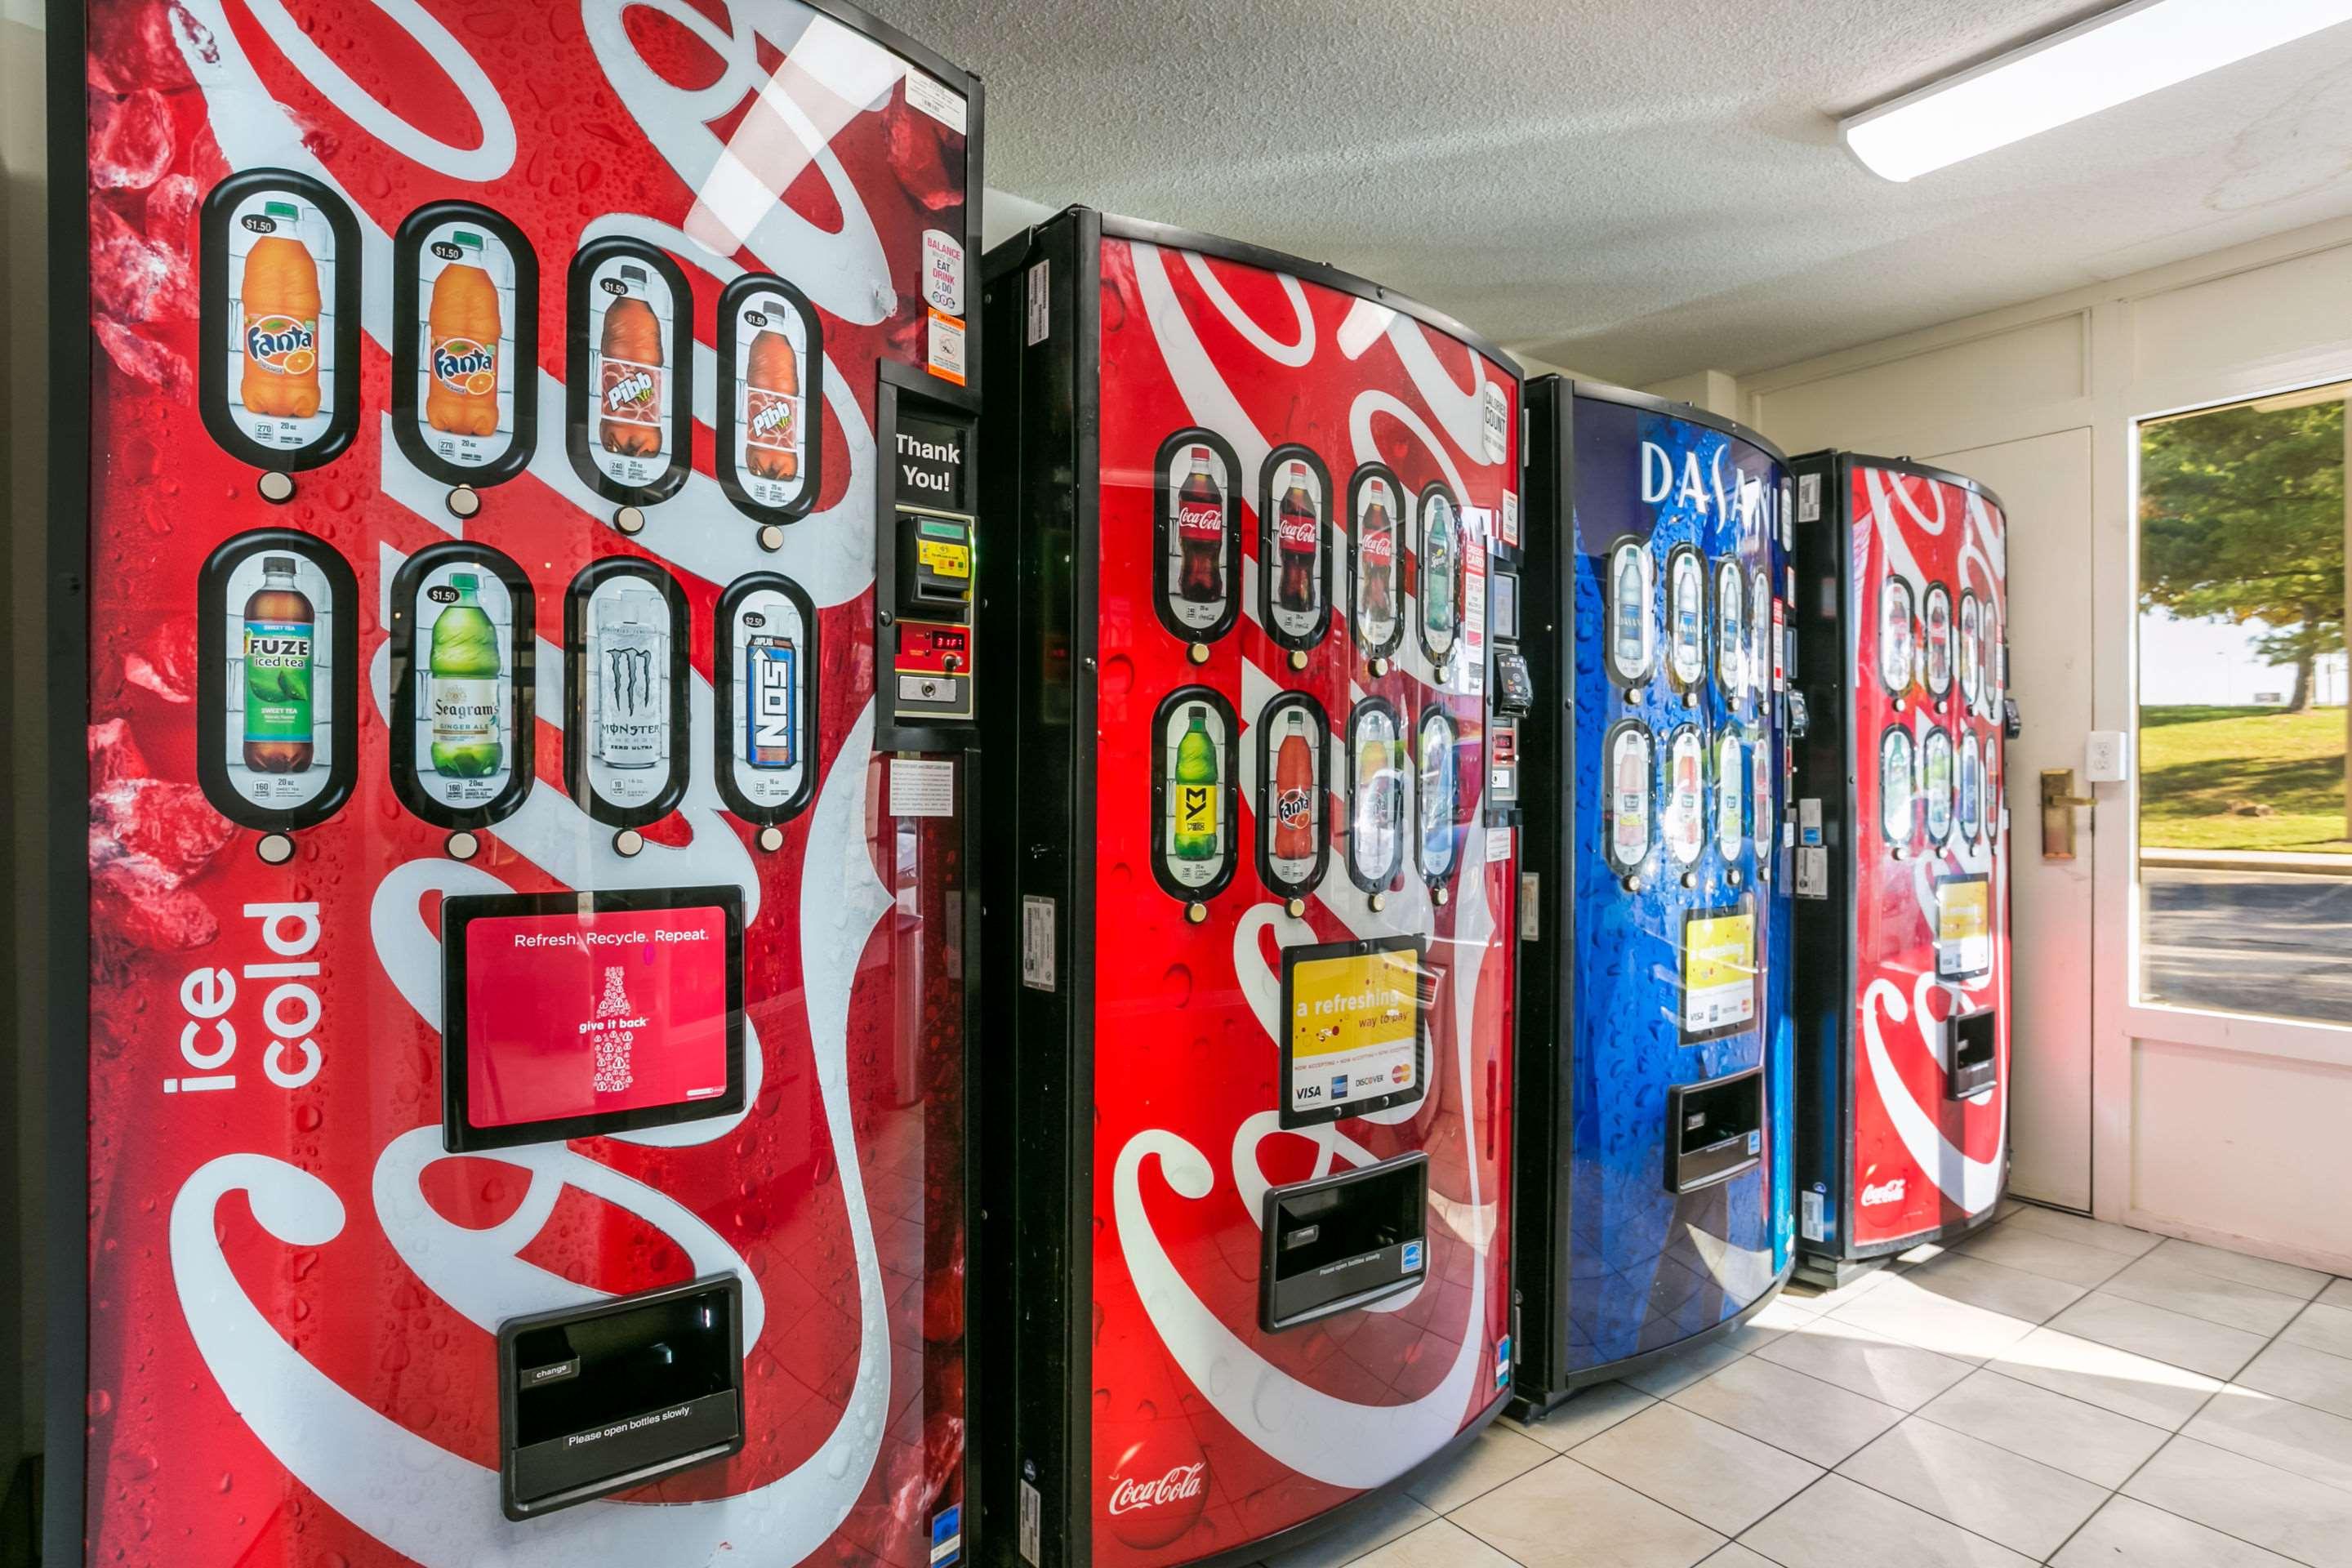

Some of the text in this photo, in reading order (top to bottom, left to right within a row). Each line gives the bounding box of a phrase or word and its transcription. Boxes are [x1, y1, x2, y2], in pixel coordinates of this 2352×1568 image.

[246, 218, 272, 233] $1.50
[436, 247, 459, 260] $1.50
[927, 238, 961, 261] BALANCE
[937, 260, 951, 272] EAT
[933, 268, 955, 286] DRINK
[604, 282, 625, 295] $1.50
[942, 283, 952, 294] DO
[747, 315, 765, 327] $1.50
[608, 372, 653, 411] Pibb
[752, 400, 790, 437] Pibb
[1485, 407, 1505, 436] COUNT
[896, 433, 960, 465] Thank
[902, 465, 950, 492] You!
[1178, 506, 1222, 531] Coca-Cola
[1280, 520, 1316, 543] Coca-Cola
[433, 590, 455, 601] $1.50
[746, 617, 762, 626] $2.50
[249, 639, 309, 656] FUZE
[255, 657, 304, 667] iced tea
[753, 648, 788, 748] NOS
[435, 699, 500, 719] Seagram's
[601, 724, 660, 735] MONSTER
[514, 929, 710, 947] Refresh. Recycle. Repeat.
[243, 902, 322, 1089] cold
[1296, 989, 1399, 1018] a refreshing
[579, 1018, 646, 1033] give it back
[1359, 1017, 1377, 1029] way
[1392, 1012, 1408, 1024] pay
[163, 967, 237, 1094] ice
[1296, 1075, 1383, 1099] VISA DISCOVER
[536, 1364, 567, 1379] change
[568, 1406, 690, 1446] Please open bottles slowly
[1109, 1462, 1205, 1515] Coca-Cola
